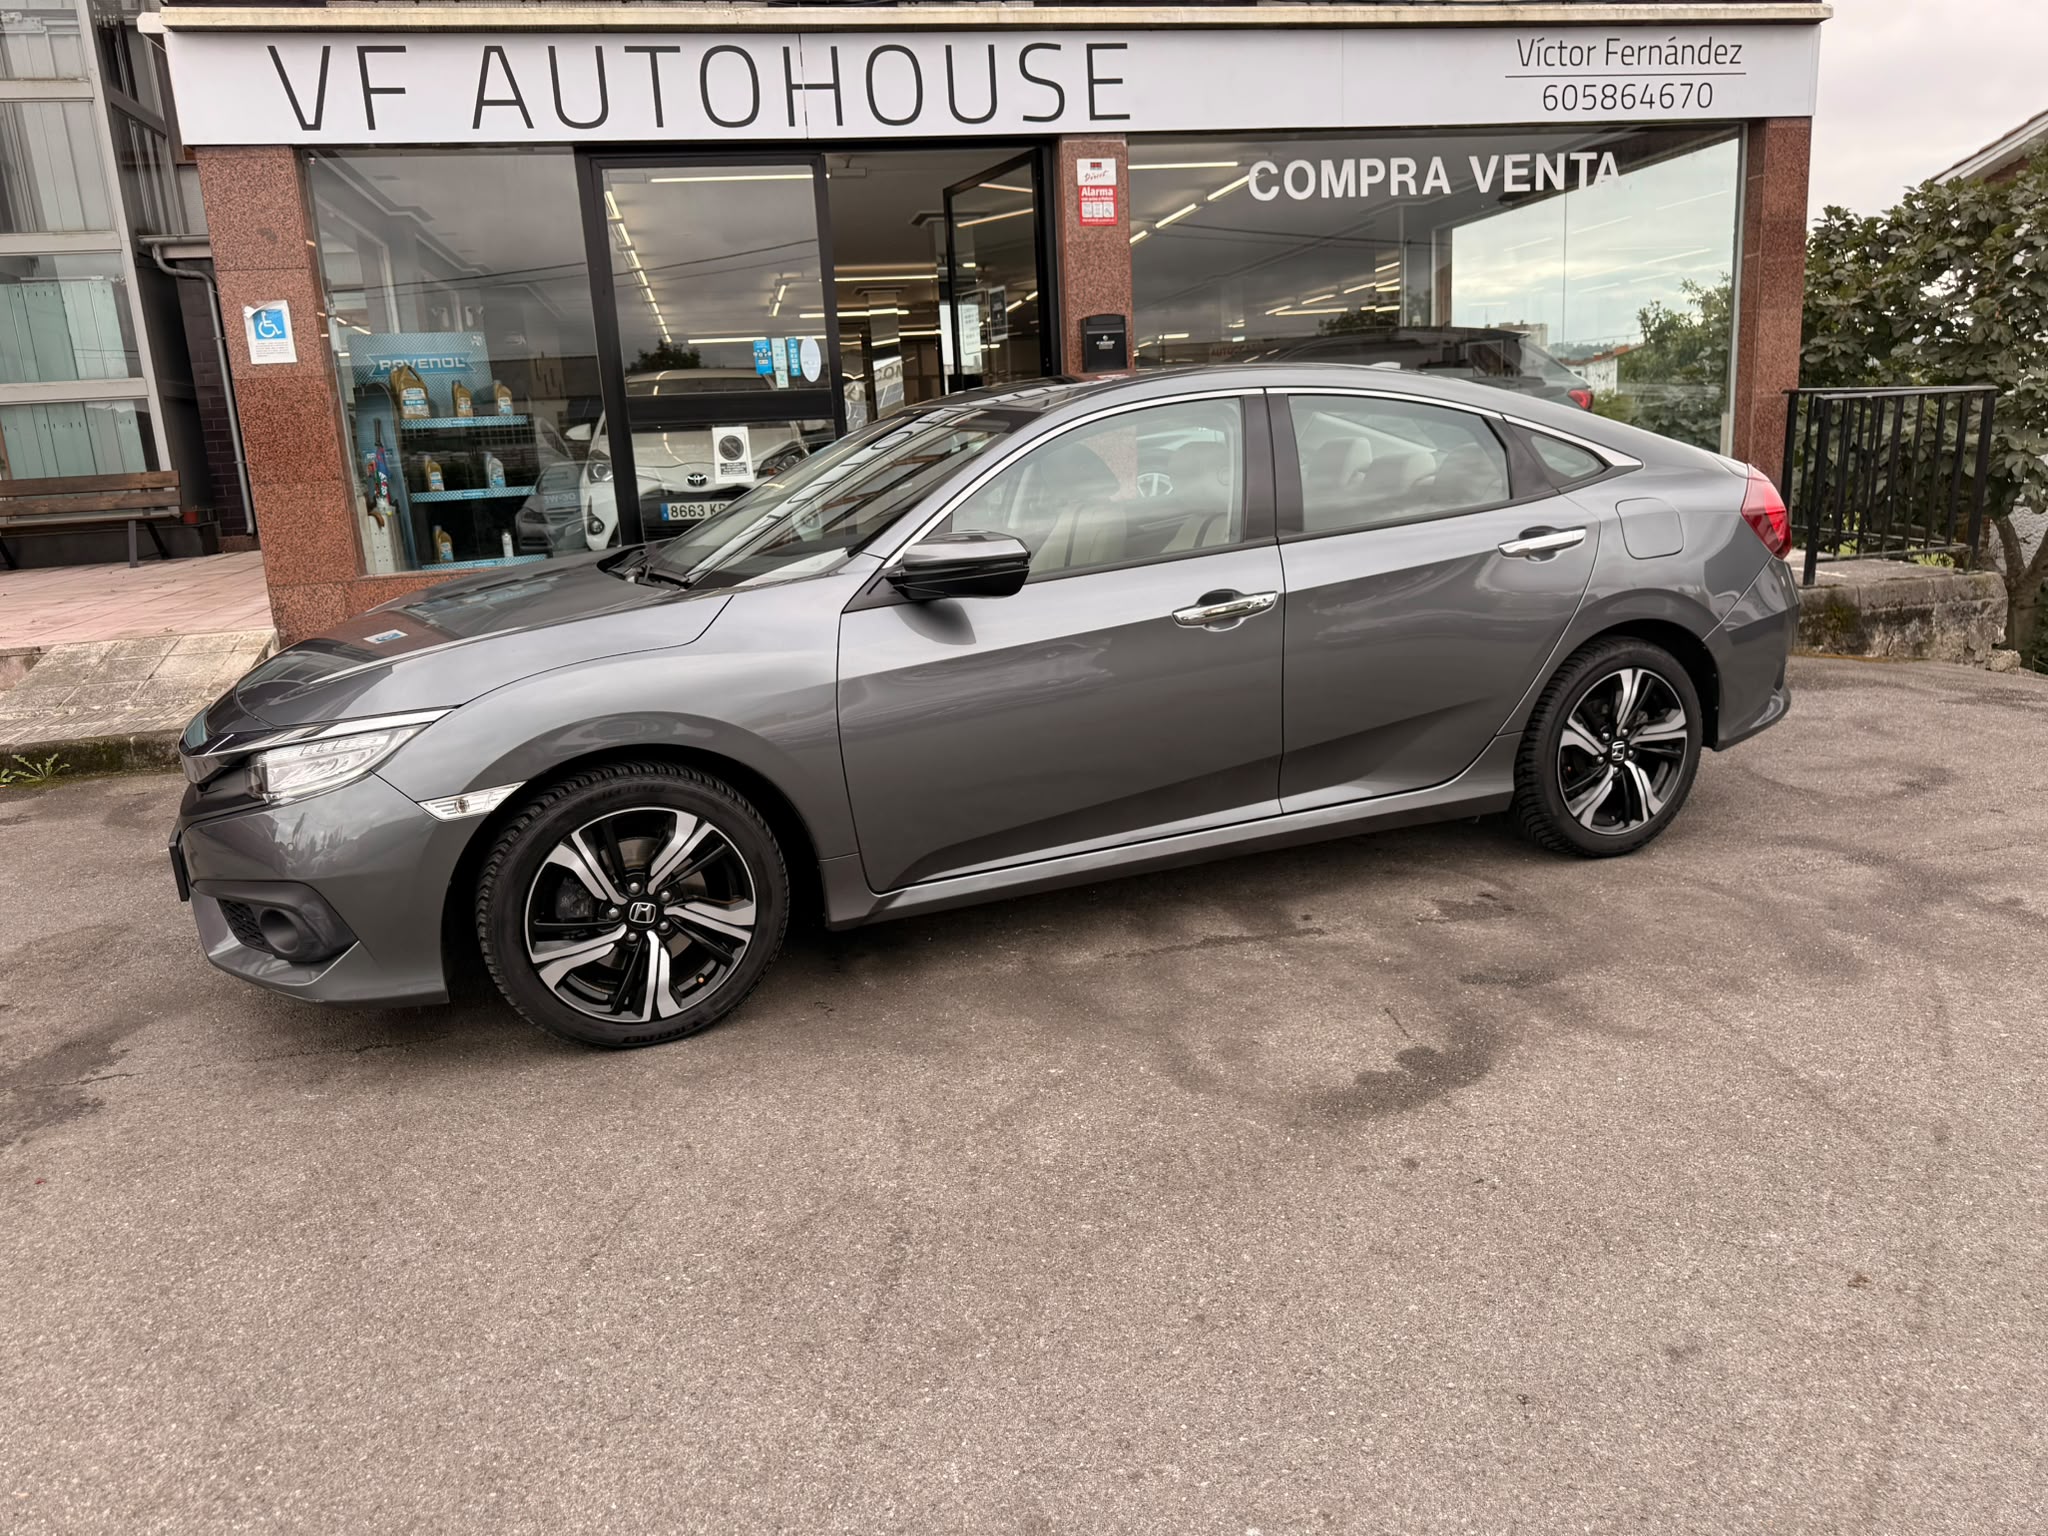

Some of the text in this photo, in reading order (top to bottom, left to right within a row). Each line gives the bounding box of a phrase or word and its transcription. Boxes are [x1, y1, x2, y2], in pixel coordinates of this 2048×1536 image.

[1516, 36, 1743, 67] Víctor Fernández
[266, 42, 1131, 131] VF AUTOHOUSE
[1542, 82, 1714, 111] 605864670
[1081, 186, 1114, 197] Alarma
[1248, 151, 1621, 202] COMPRA VENTA
[671, 504, 705, 519] 8663
